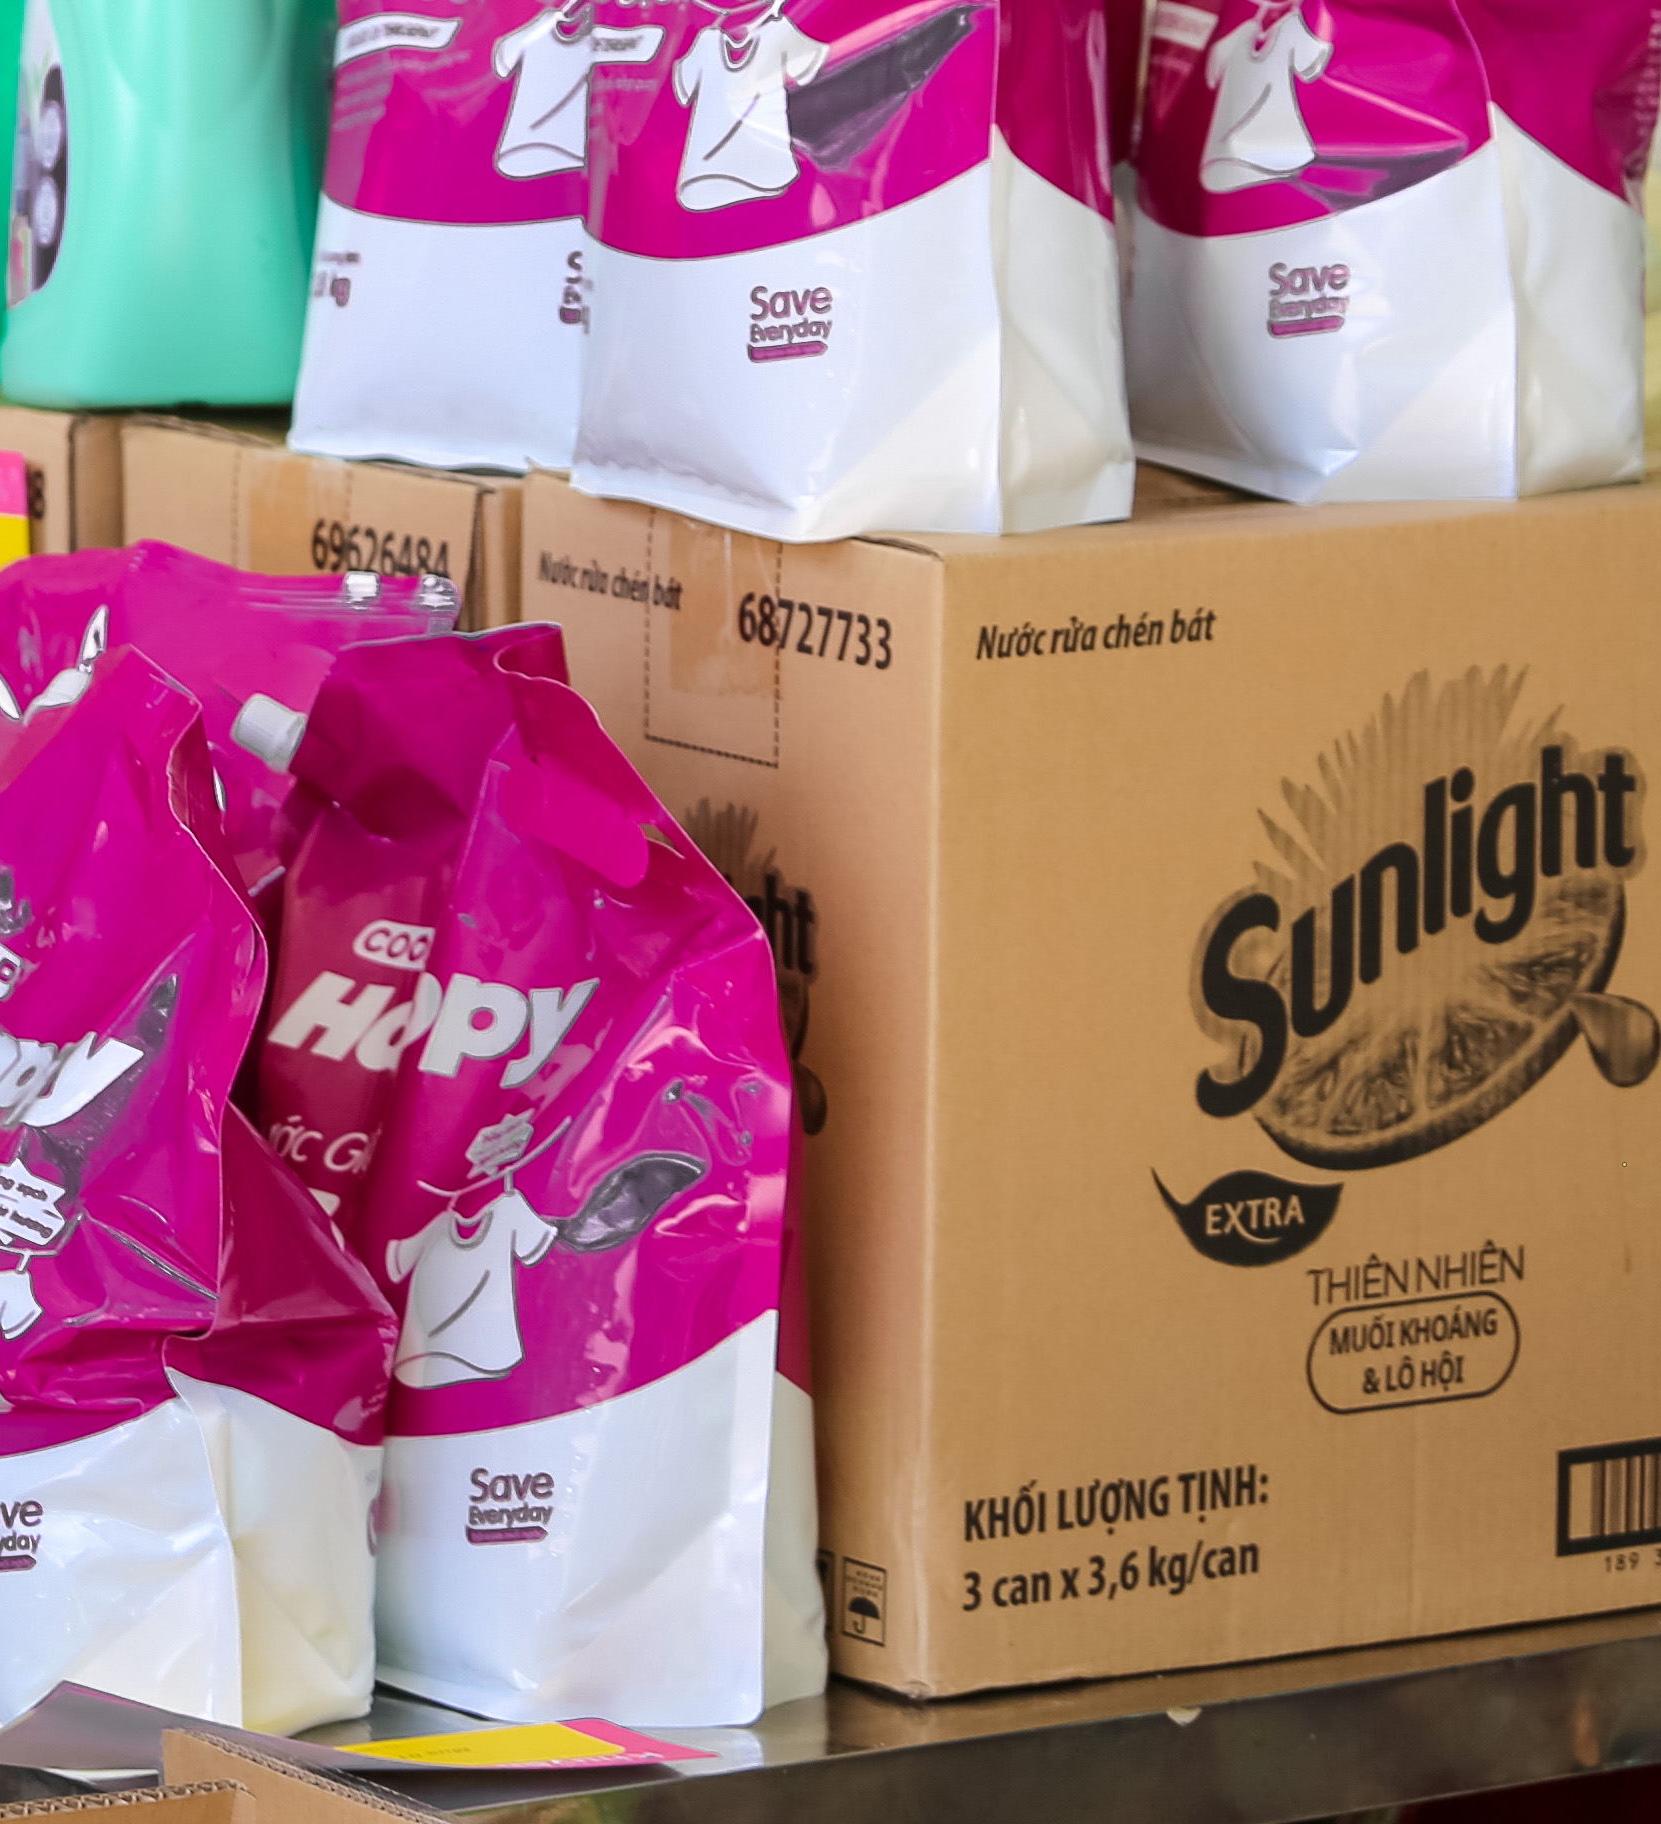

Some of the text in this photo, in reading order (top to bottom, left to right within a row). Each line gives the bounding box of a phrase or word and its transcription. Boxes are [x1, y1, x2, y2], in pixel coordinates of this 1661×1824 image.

[749, 285, 833, 321] Save
[1268, 261, 1352, 297] Save
[750, 317, 833, 344] Everyday
[311, 517, 452, 578] 69626484
[738, 590, 893, 671] 68727733
[975, 607, 1217, 660] Nước rửa chén bát
[1195, 744, 1639, 1119] Sunlight
[1204, 1194, 1306, 1240] EXTRA
[1306, 1238, 1526, 1306] THIÊN NHIÊN
[1329, 1304, 1499, 1356] MUỐI KHOÁNG
[1362, 1350, 1465, 1395] & LÔ HỘI
[468, 1467, 555, 1504] Save
[963, 1463, 1269, 1543] KHỐI LƯỢNG TỊNH:
[468, 1502, 554, 1528] Everyday
[962, 1538, 1260, 1612] 3 can x 3,6 kg/can
